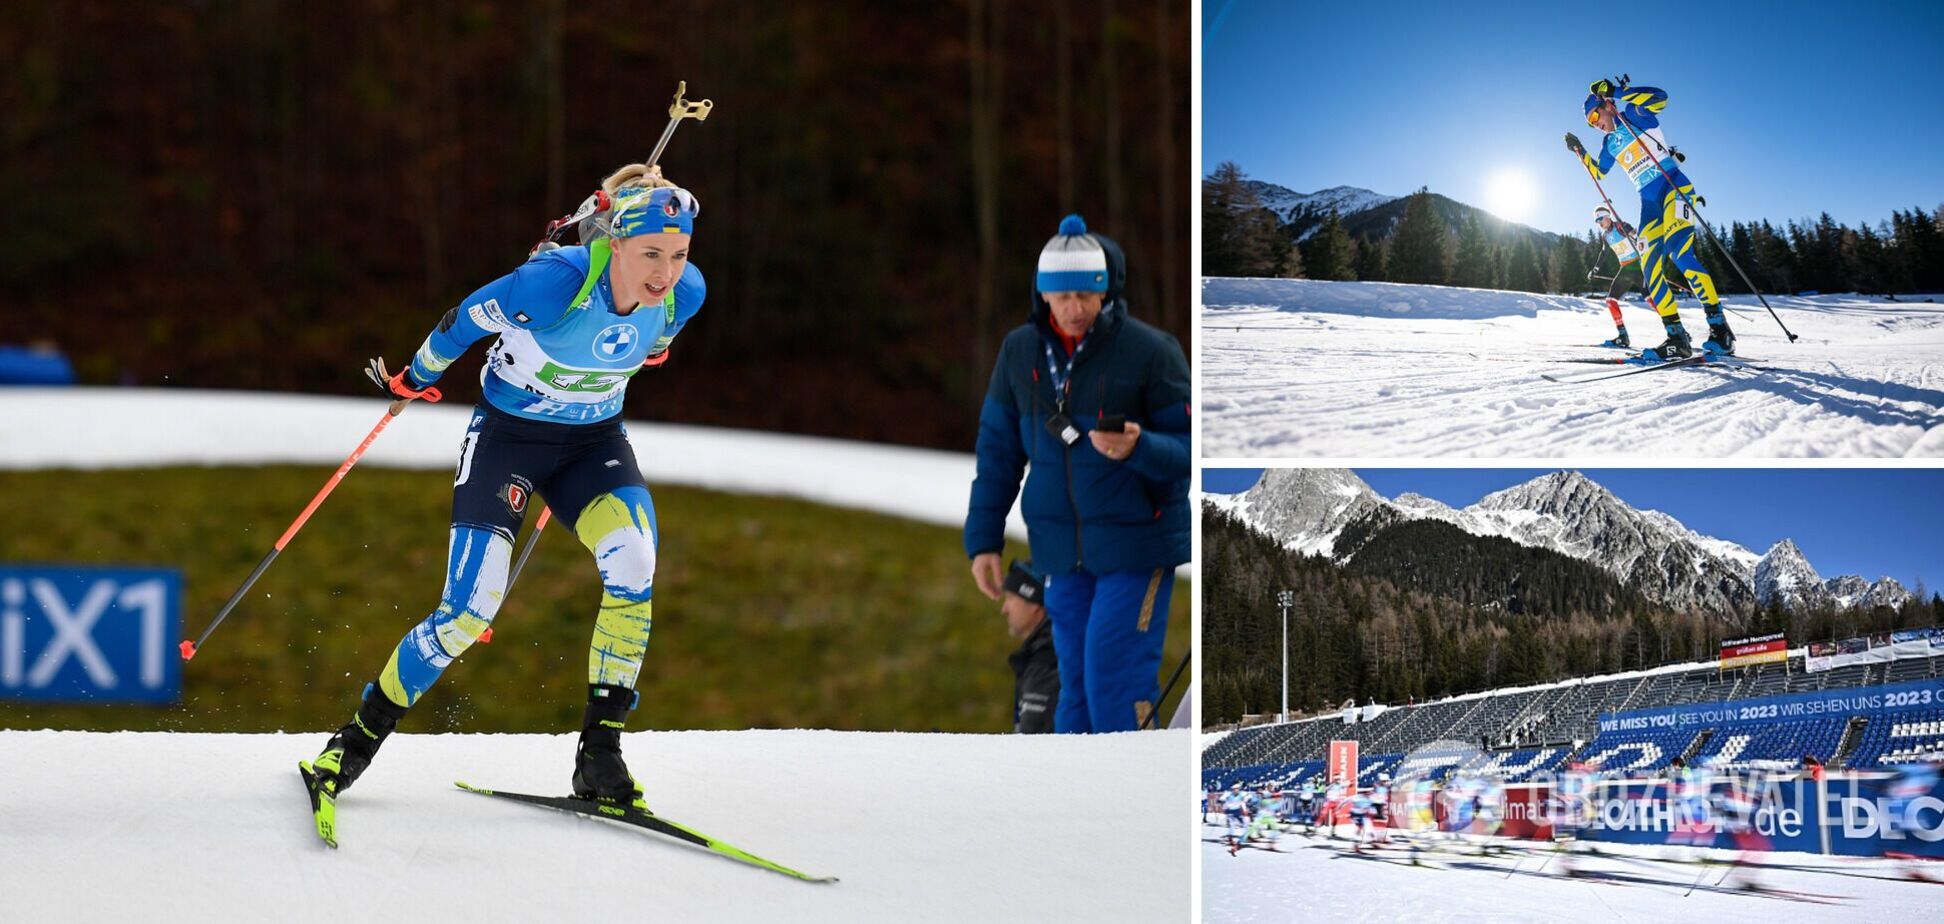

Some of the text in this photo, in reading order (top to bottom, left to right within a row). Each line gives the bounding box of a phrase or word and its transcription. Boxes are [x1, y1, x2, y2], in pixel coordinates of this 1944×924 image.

[1683, 204, 1690, 220] 6
[1, 578, 168, 689] iX1
[1601, 719, 1618, 732] WE
[1620, 717, 1648, 731] MISS
[1650, 713, 1676, 727] YOU
[1679, 712, 1700, 725] SEE
[1700, 710, 1724, 723] YOU
[1725, 709, 1737, 722] IN
[1740, 705, 1778, 720] 2023
[1780, 702, 1805, 717] WIR
[1806, 698, 1850, 714] SEHEN
[1852, 695, 1882, 711] UNS
[1884, 689, 1932, 708] 2023
